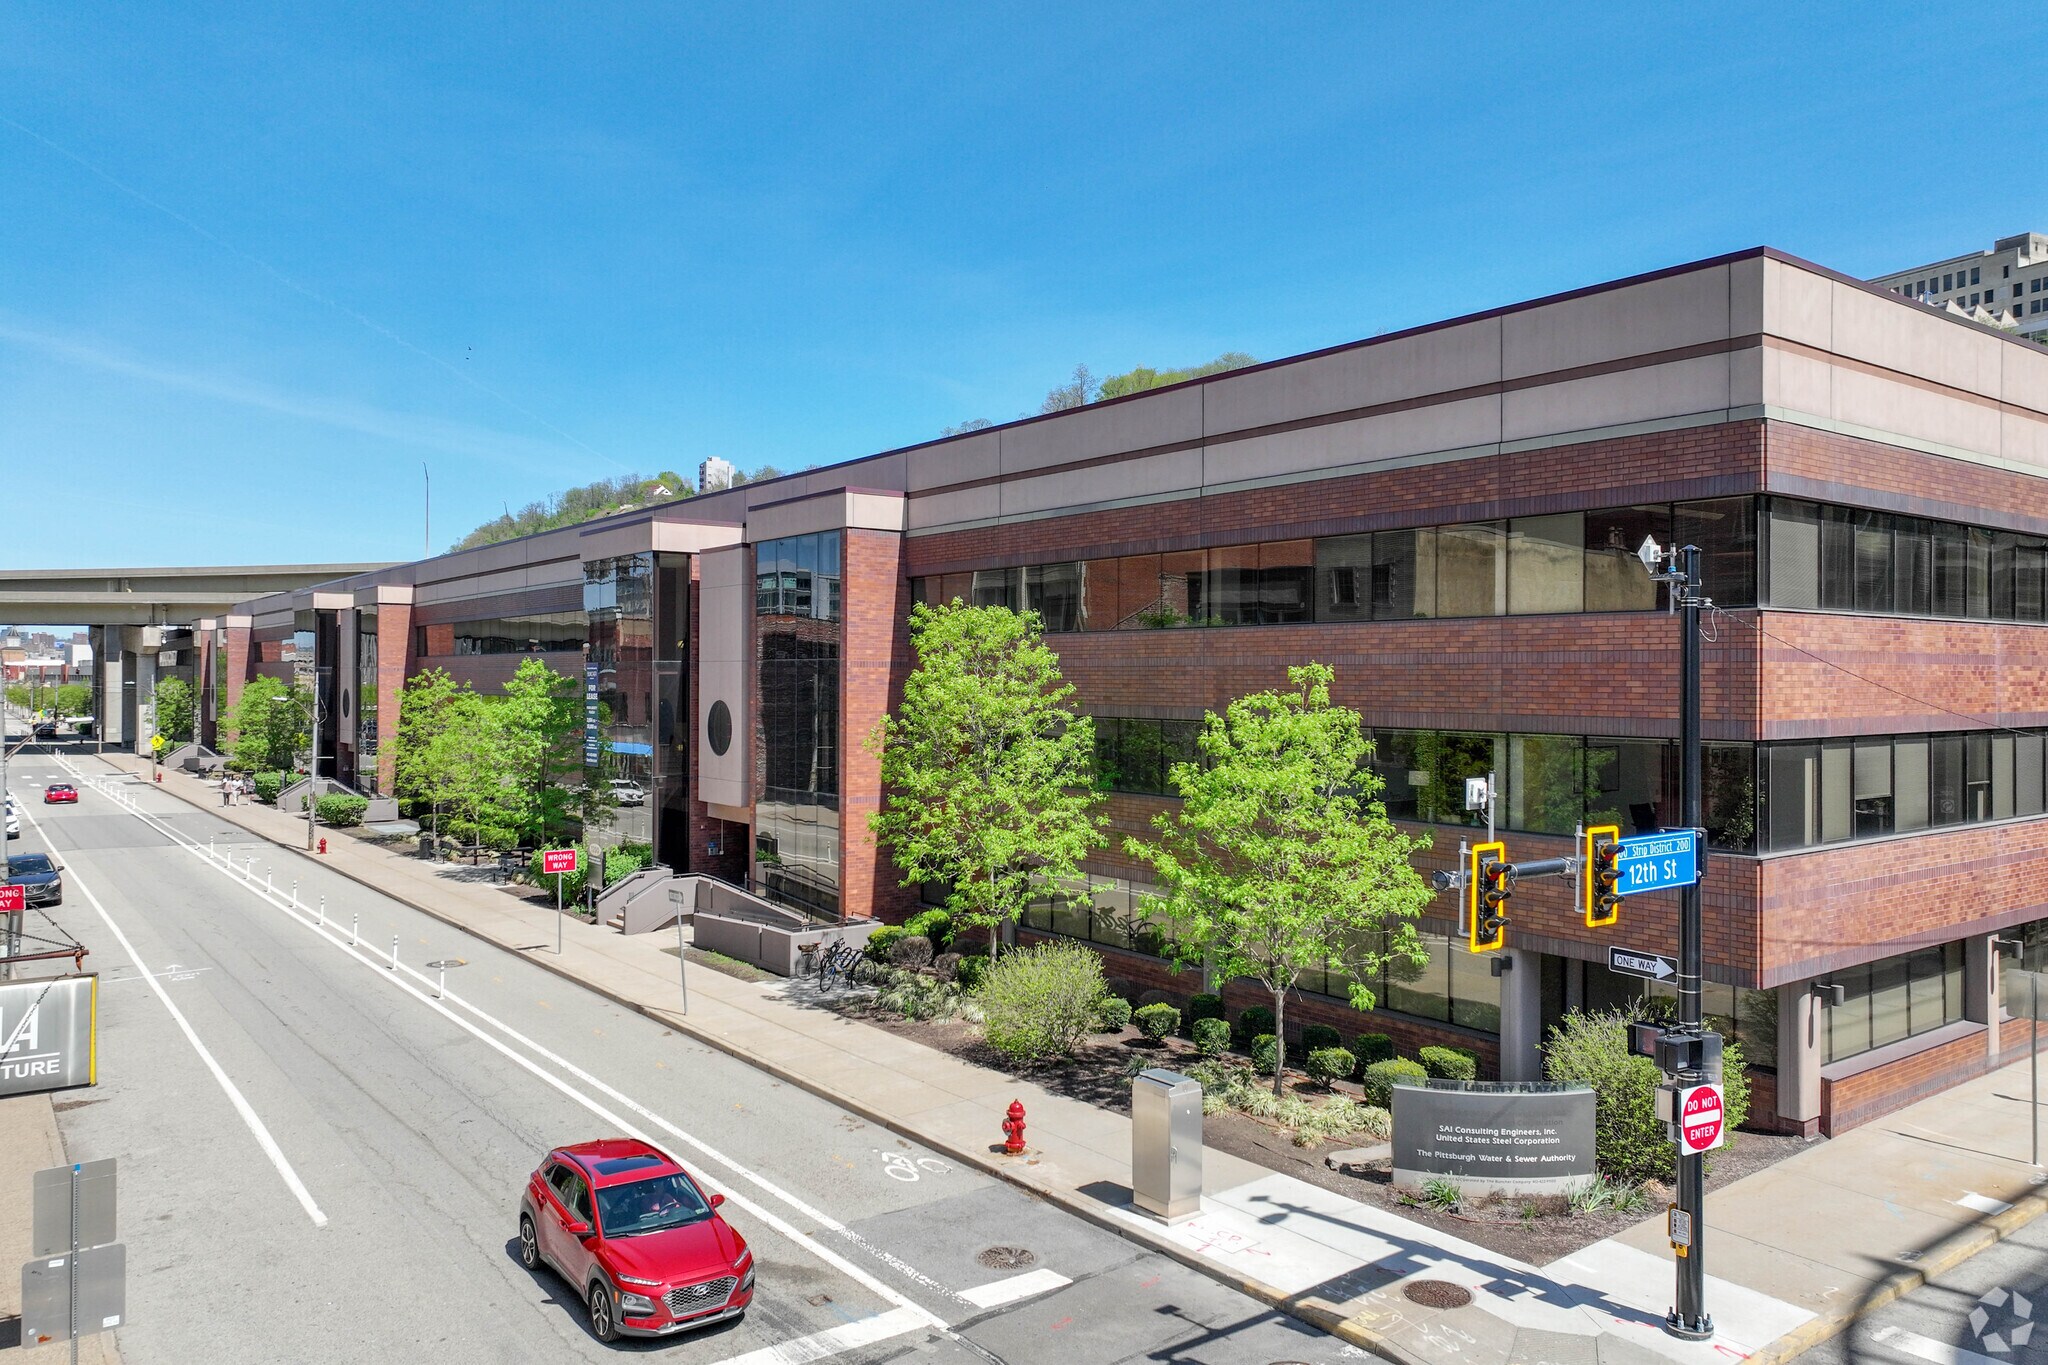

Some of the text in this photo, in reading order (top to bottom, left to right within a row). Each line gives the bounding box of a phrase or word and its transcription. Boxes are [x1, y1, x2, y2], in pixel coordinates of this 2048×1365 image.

[1632, 845, 1648, 857] Strip
[1650, 841, 1673, 854] District
[1677, 839, 1689, 851] 200
[547, 853, 573, 861] WRONG
[1629, 858, 1677, 884] 12th St
[0, 890, 20, 899] ONG
[0, 899, 12, 908] AY
[1616, 955, 1657, 971] ONE WAY
[0, 1059, 60, 1080] TURE
[1425, 1080, 1459, 1091] PENN
[1464, 1082, 1515, 1093] LIBERTY
[1520, 1083, 1558, 1093] PLAZA
[1687, 1095, 1717, 1112] DO NOT
[1438, 1125, 1453, 1133] SAI
[1455, 1126, 1499, 1137] Consulting
[1500, 1128, 1542, 1137] Engineers,
[1690, 1125, 1715, 1140] ENTER
[1435, 1134, 1560, 1146] United States Steel Corporation
[1416, 1149, 1576, 1163] The Pittsburgh Water & Sewer Authority
